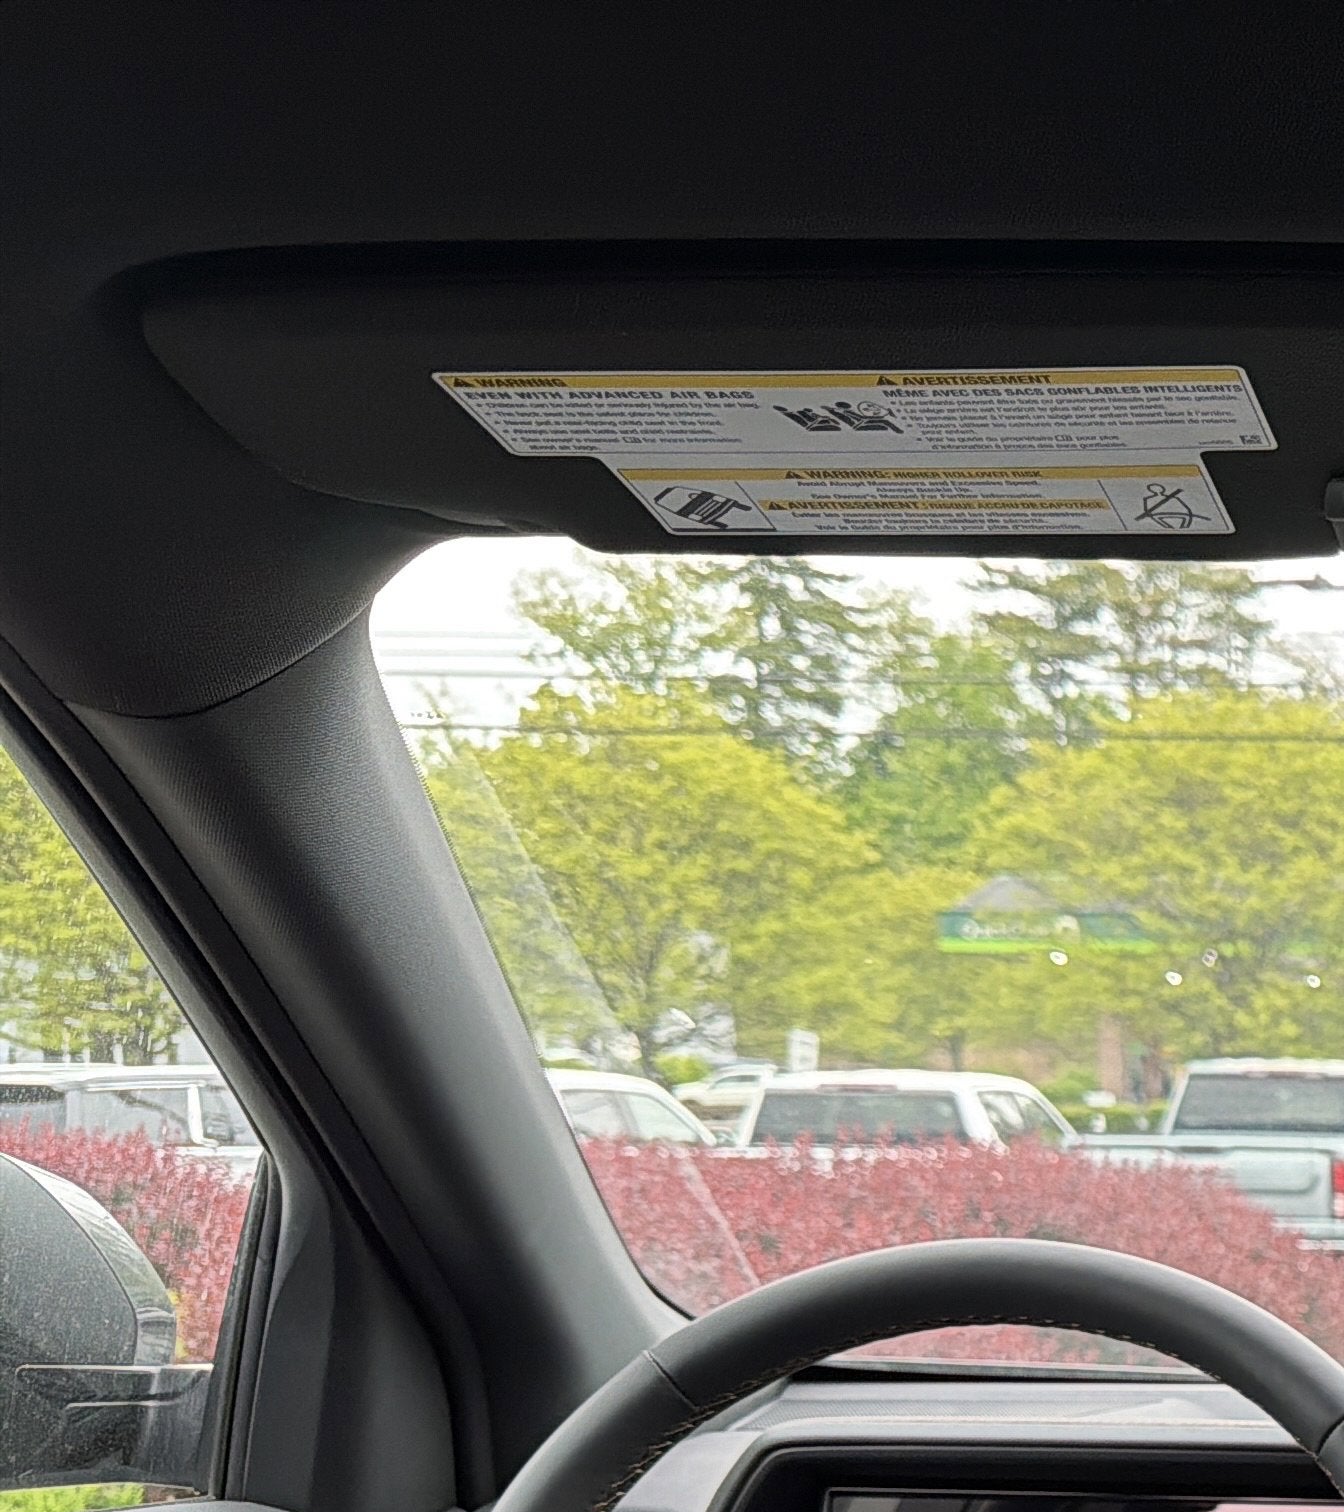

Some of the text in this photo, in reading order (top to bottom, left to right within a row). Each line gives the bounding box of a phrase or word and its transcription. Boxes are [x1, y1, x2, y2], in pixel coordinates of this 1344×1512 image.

[475, 378, 568, 388] WARNING
[903, 374, 1051, 386] AVERTISSEMENT
[464, 391, 755, 400] EVEN WITH ADVANCED AIR BAGS
[932, 389, 970, 398] AVEC
[972, 388, 1002, 397] DES
[1004, 388, 1044, 396] SACS
[1048, 386, 1141, 396] GONFLABLES
[1144, 384, 1243, 394] INTELLIGENTS
